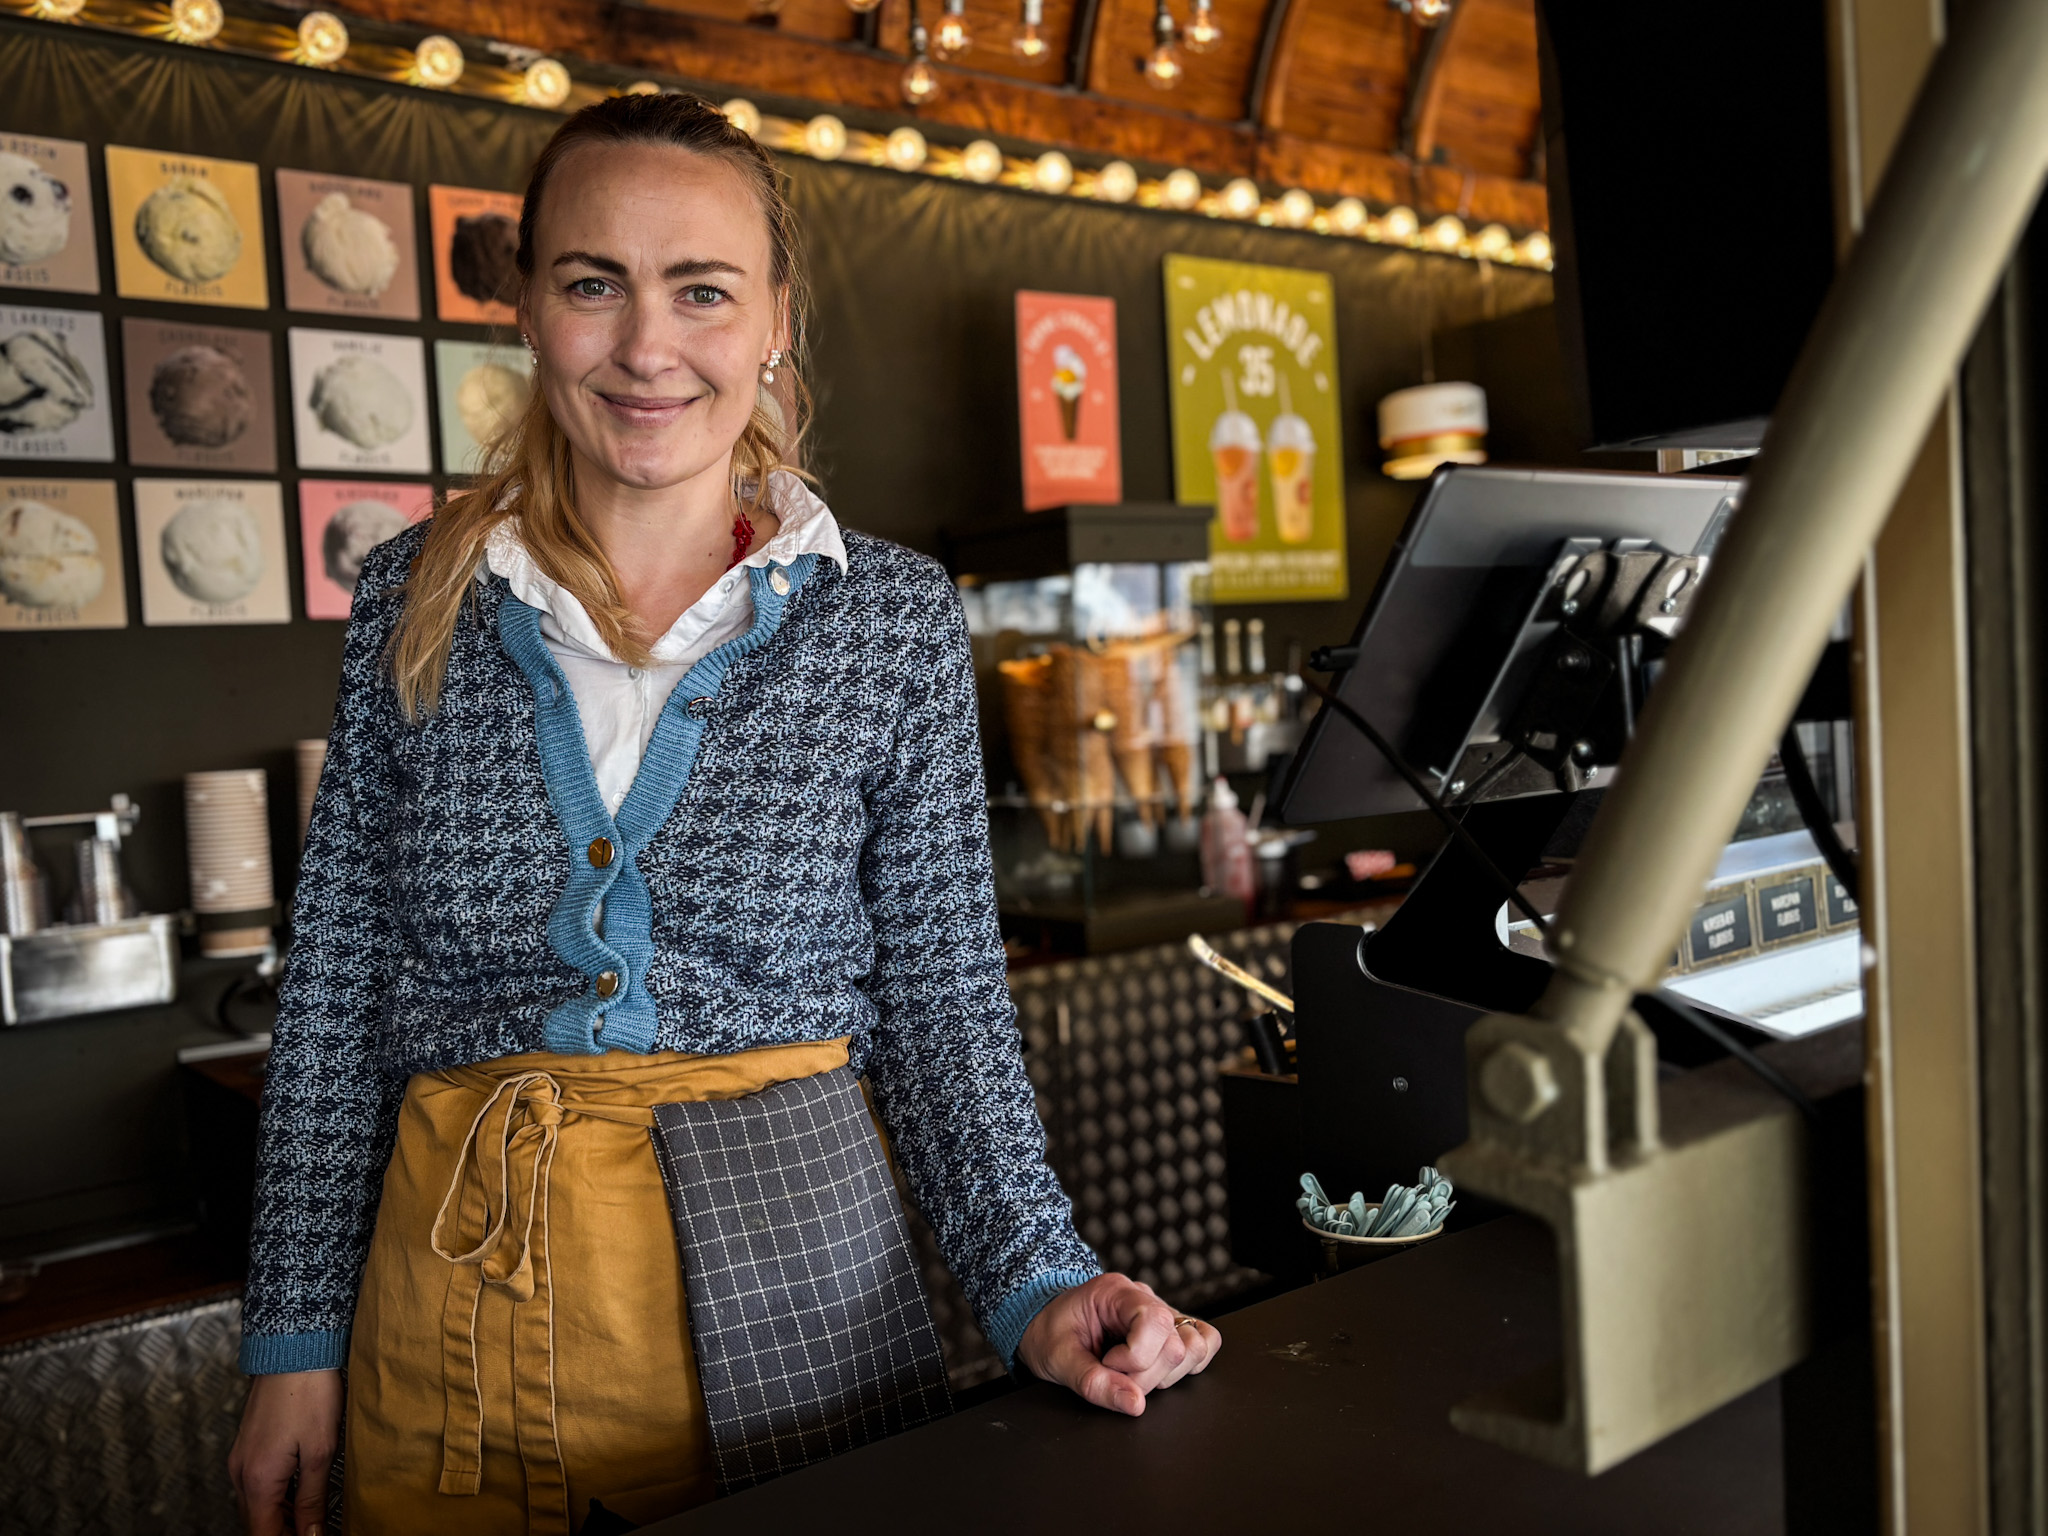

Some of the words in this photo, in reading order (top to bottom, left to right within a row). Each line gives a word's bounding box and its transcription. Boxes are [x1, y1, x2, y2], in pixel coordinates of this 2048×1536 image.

[10, 311, 76, 332] LAKRIDS
[1183, 289, 1323, 369] LEMONADE
[1238, 345, 1276, 397] 35
